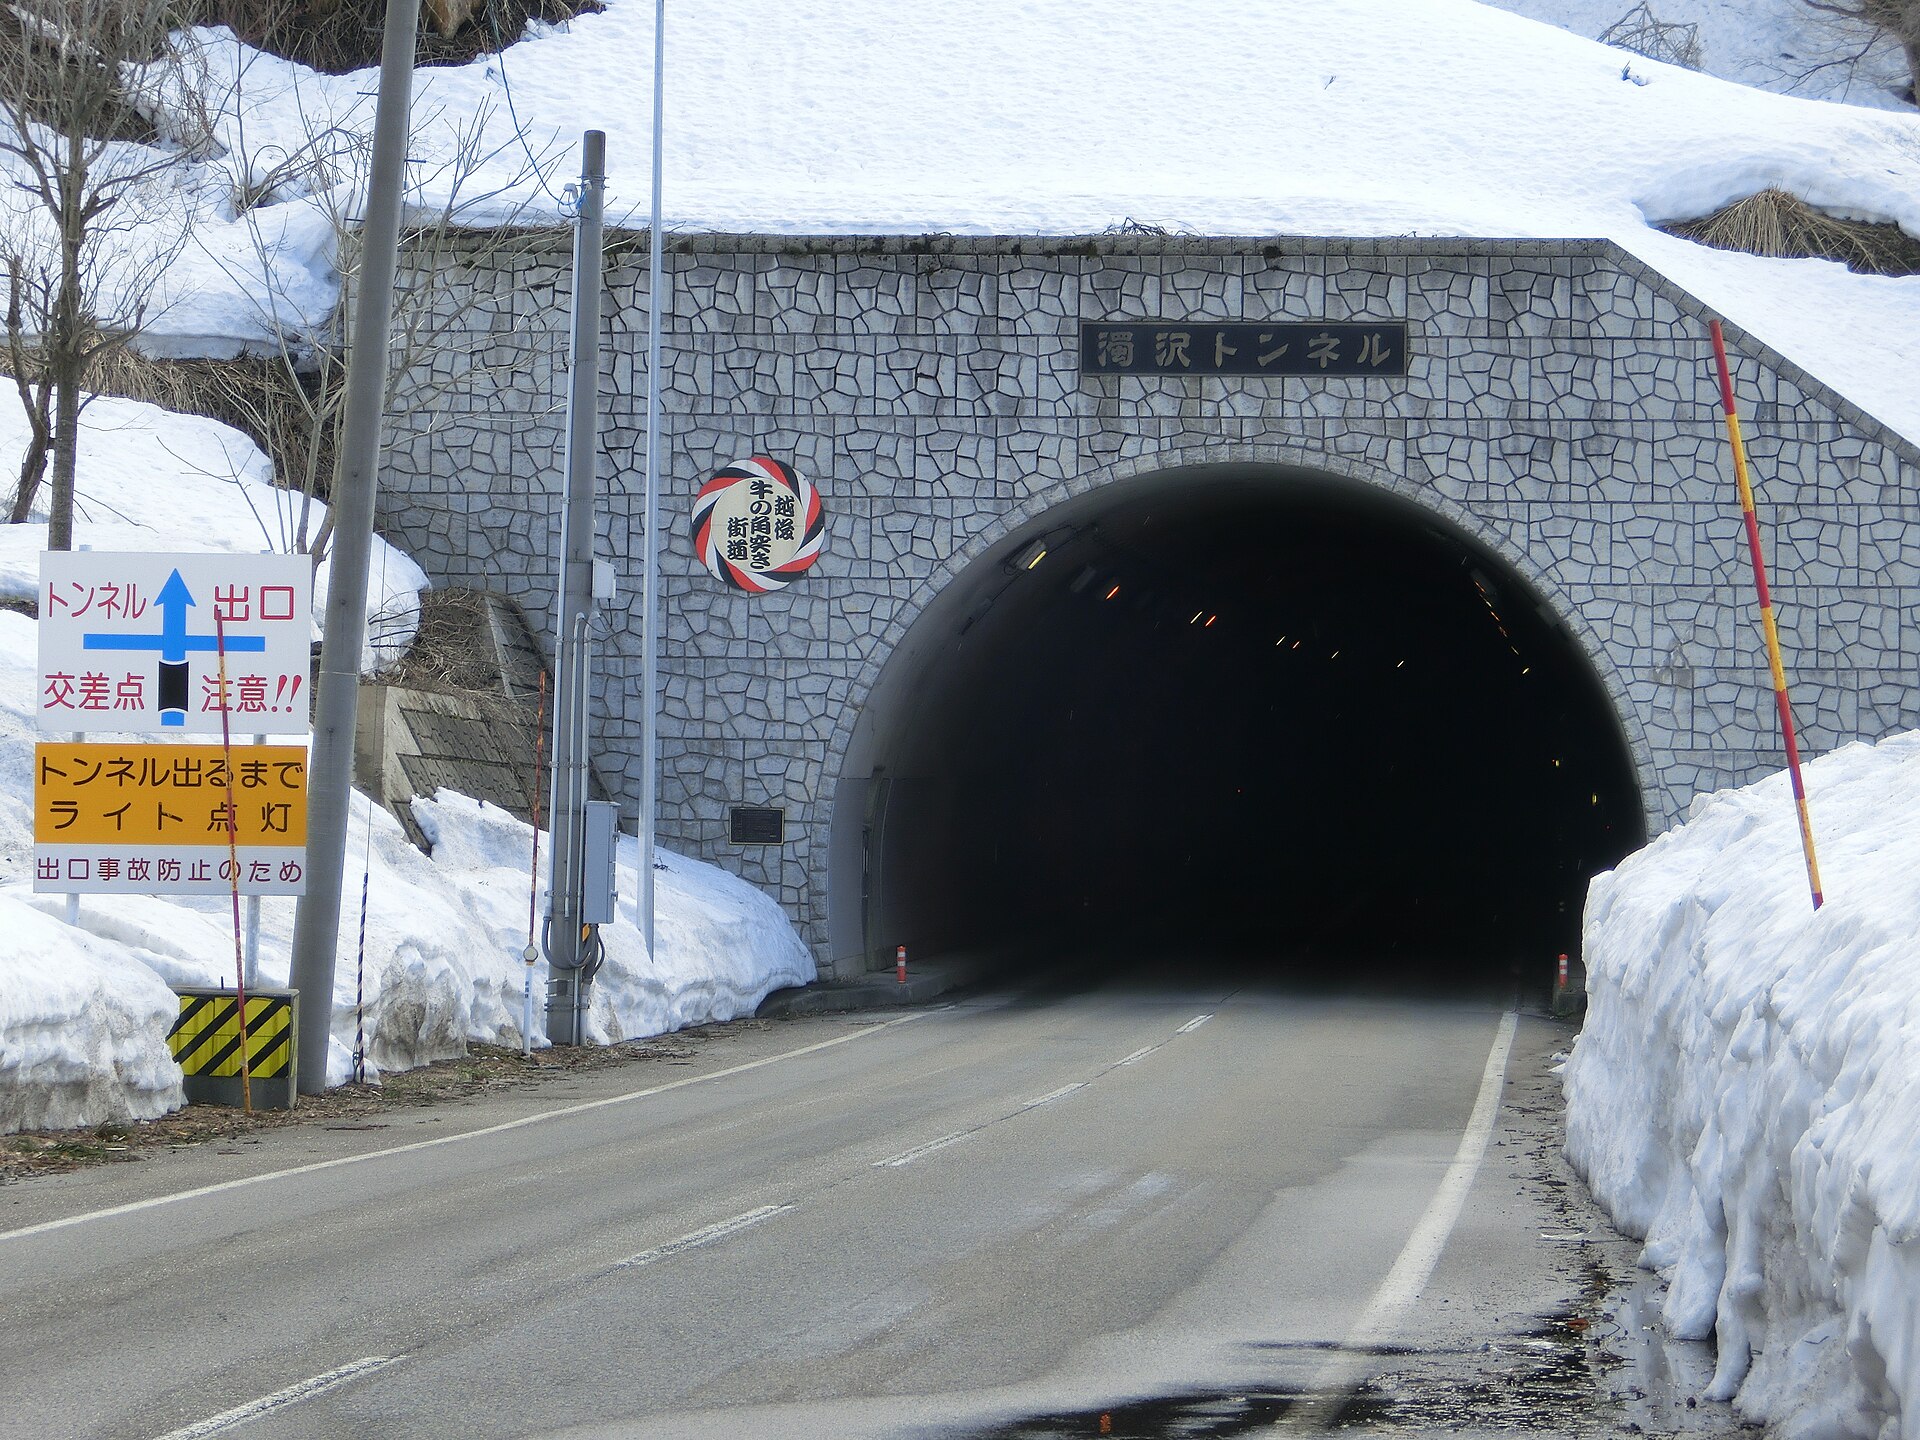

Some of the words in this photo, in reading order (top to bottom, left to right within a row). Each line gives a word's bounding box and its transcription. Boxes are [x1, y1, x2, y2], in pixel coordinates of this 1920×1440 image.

[750, 480, 774, 569] 牛の角突き
[774, 495, 795, 540] 越後
[727, 517, 749, 561] 街道
[48, 581, 147, 620] トンネル
[213, 583, 295, 622] 出口
[44, 671, 146, 711] 交差点
[201, 673, 303, 713] 注意!!
[41, 756, 304, 789] トンネル出るまで
[49, 800, 292, 833] ライト点灯
[37, 857, 302, 883] 出口事故防止のため
